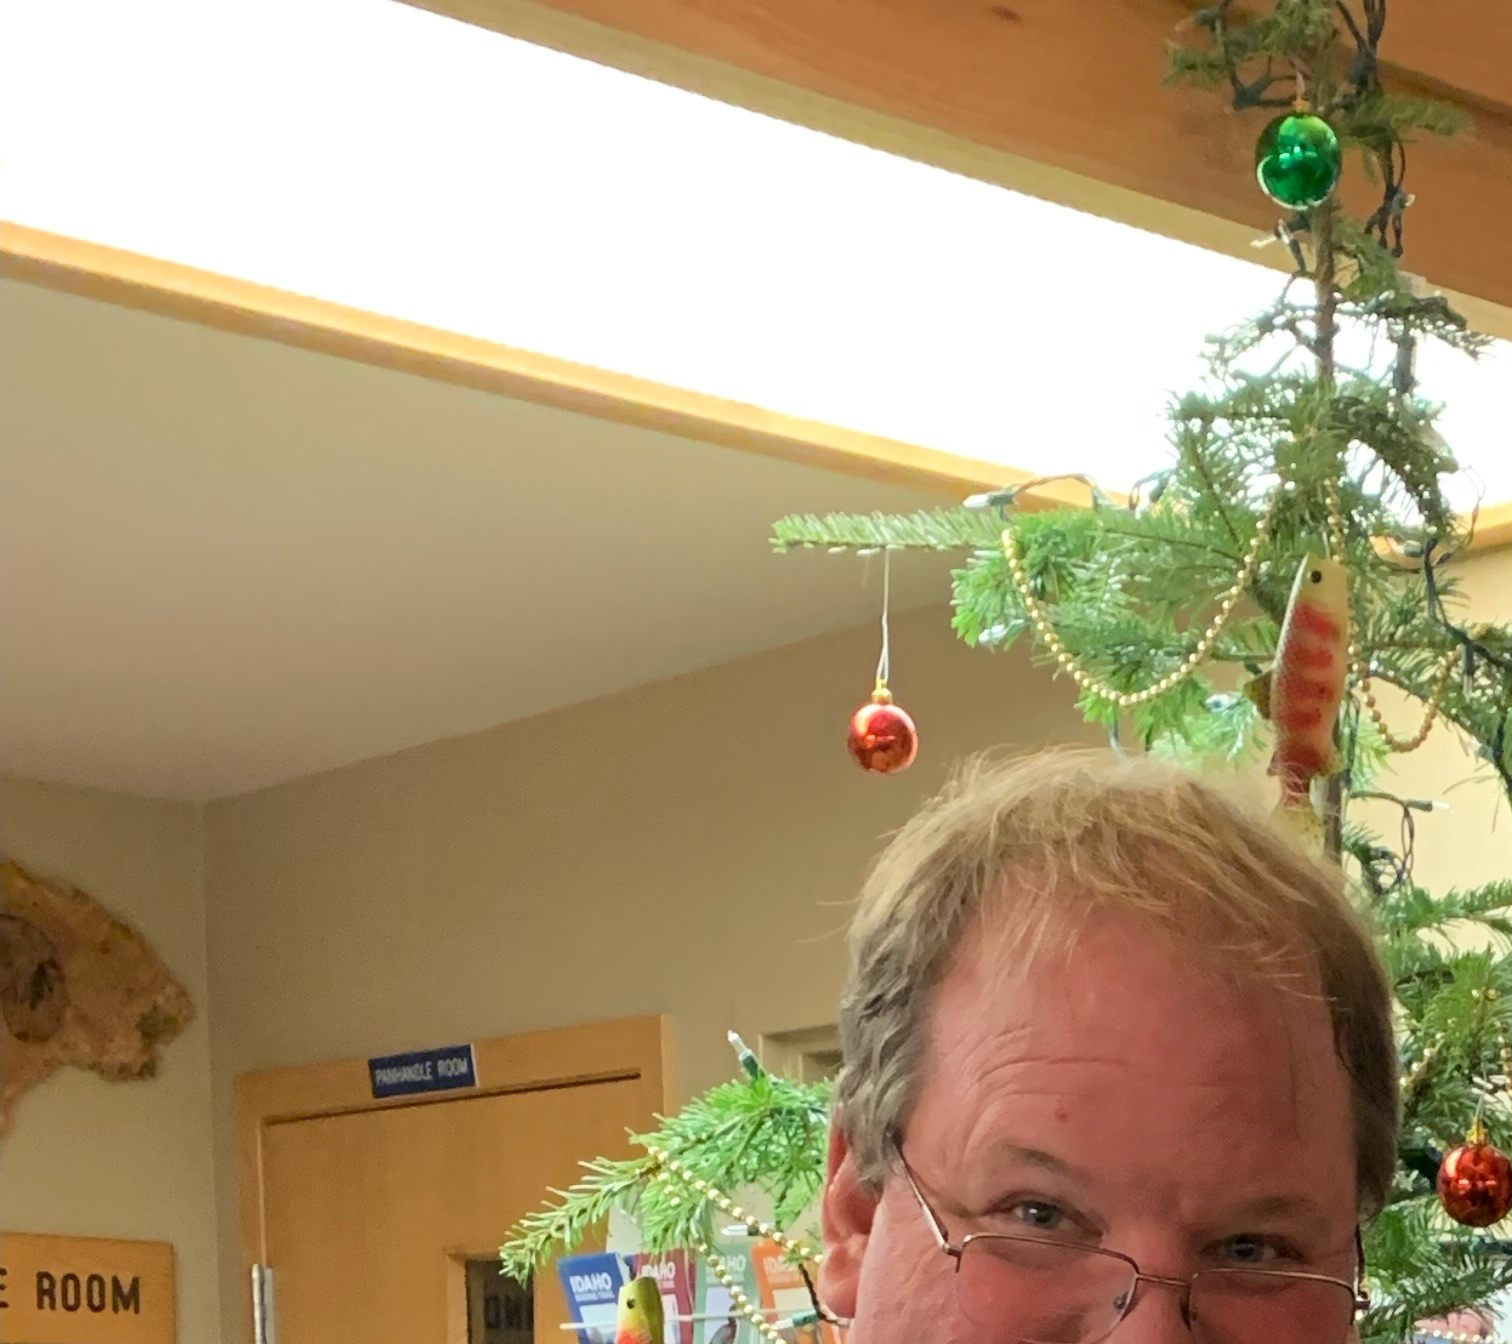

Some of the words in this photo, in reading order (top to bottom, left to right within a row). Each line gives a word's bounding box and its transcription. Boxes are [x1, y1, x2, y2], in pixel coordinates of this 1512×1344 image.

[437, 1057, 468, 1076] ROOM
[36, 1271, 140, 1315] ROOM
[569, 1271, 613, 1293] IDAHO
